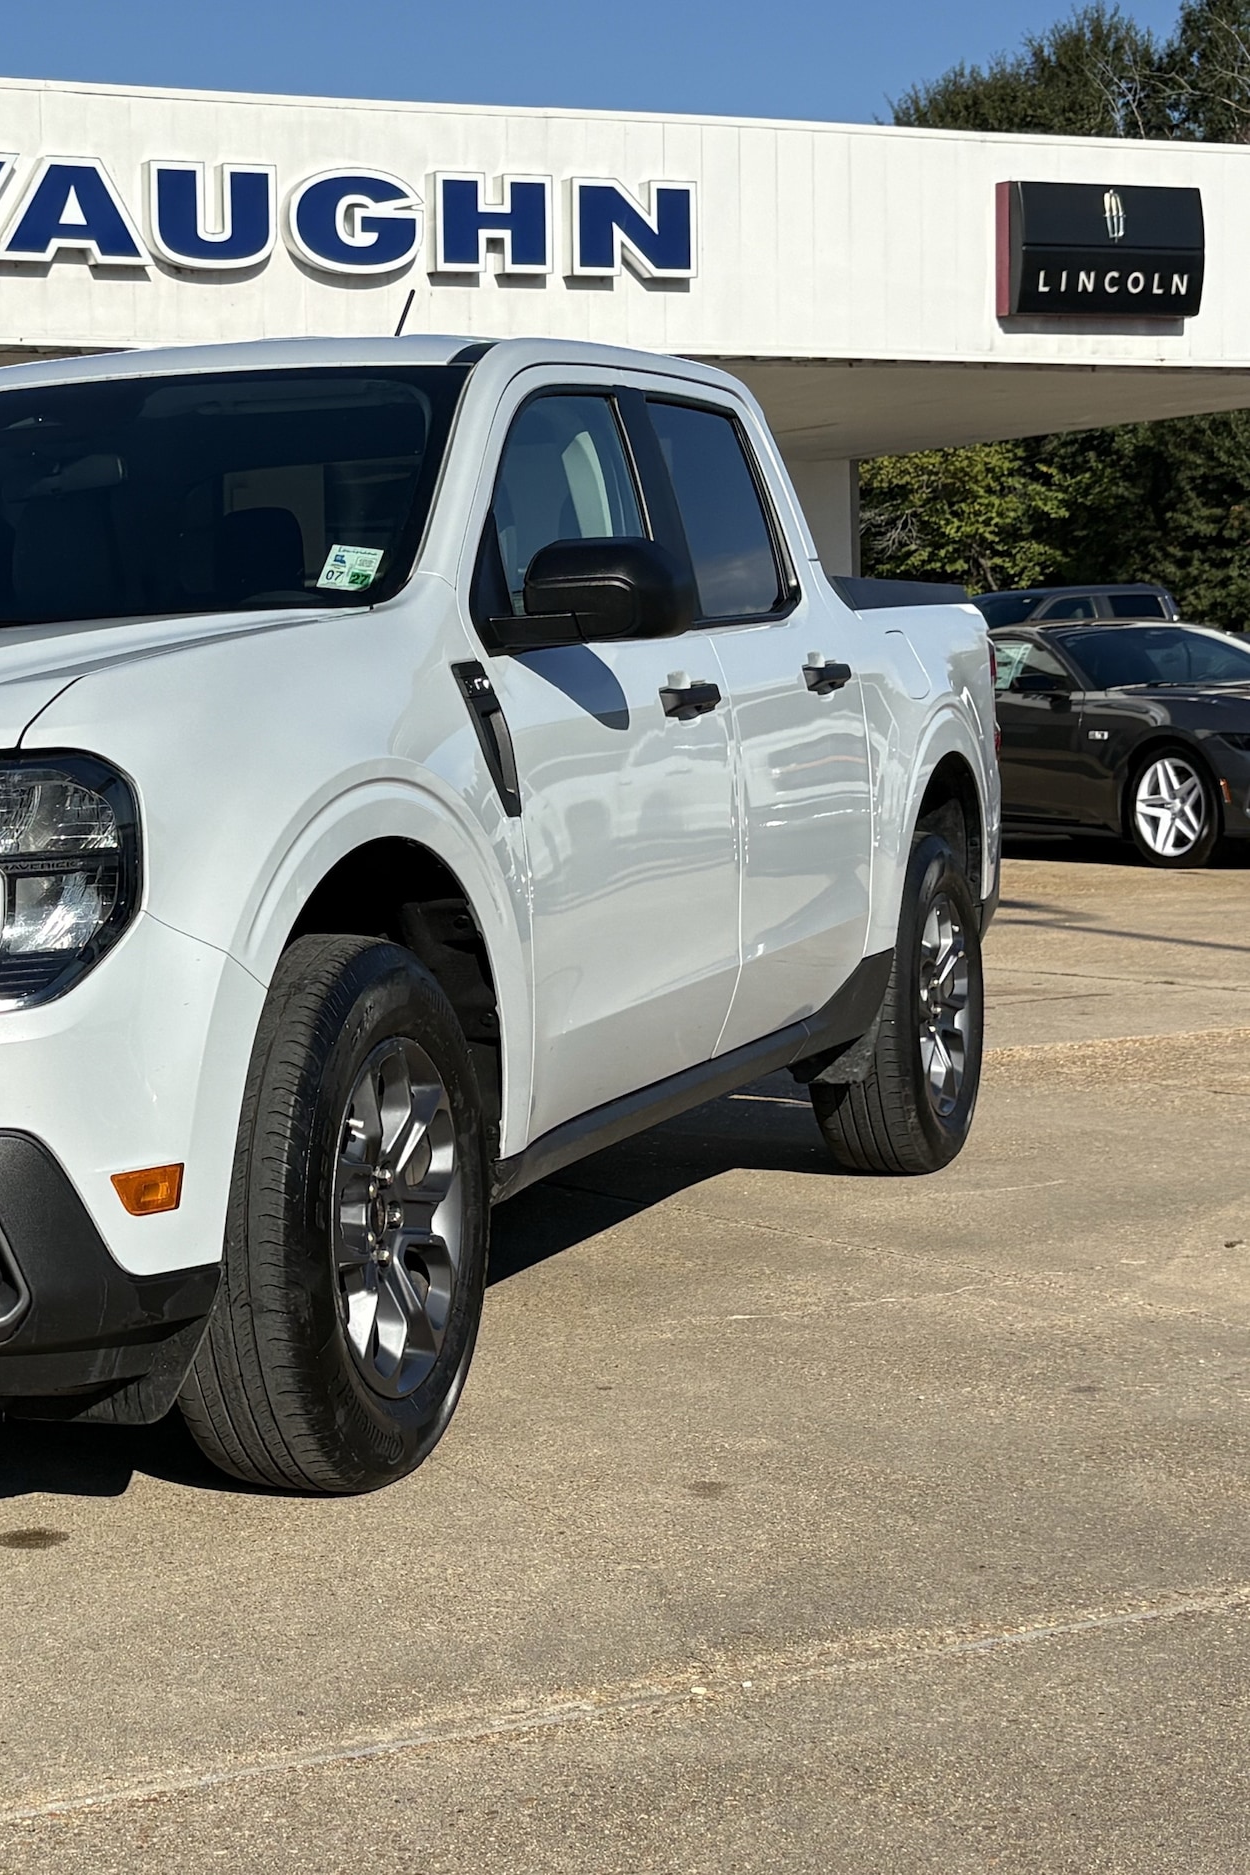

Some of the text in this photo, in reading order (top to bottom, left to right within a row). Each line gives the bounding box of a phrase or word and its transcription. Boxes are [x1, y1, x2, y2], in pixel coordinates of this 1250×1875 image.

[1037, 270, 1189, 295] LINCOLN
[325, 569, 344, 581] 07
[348, 572, 369, 585] 27
